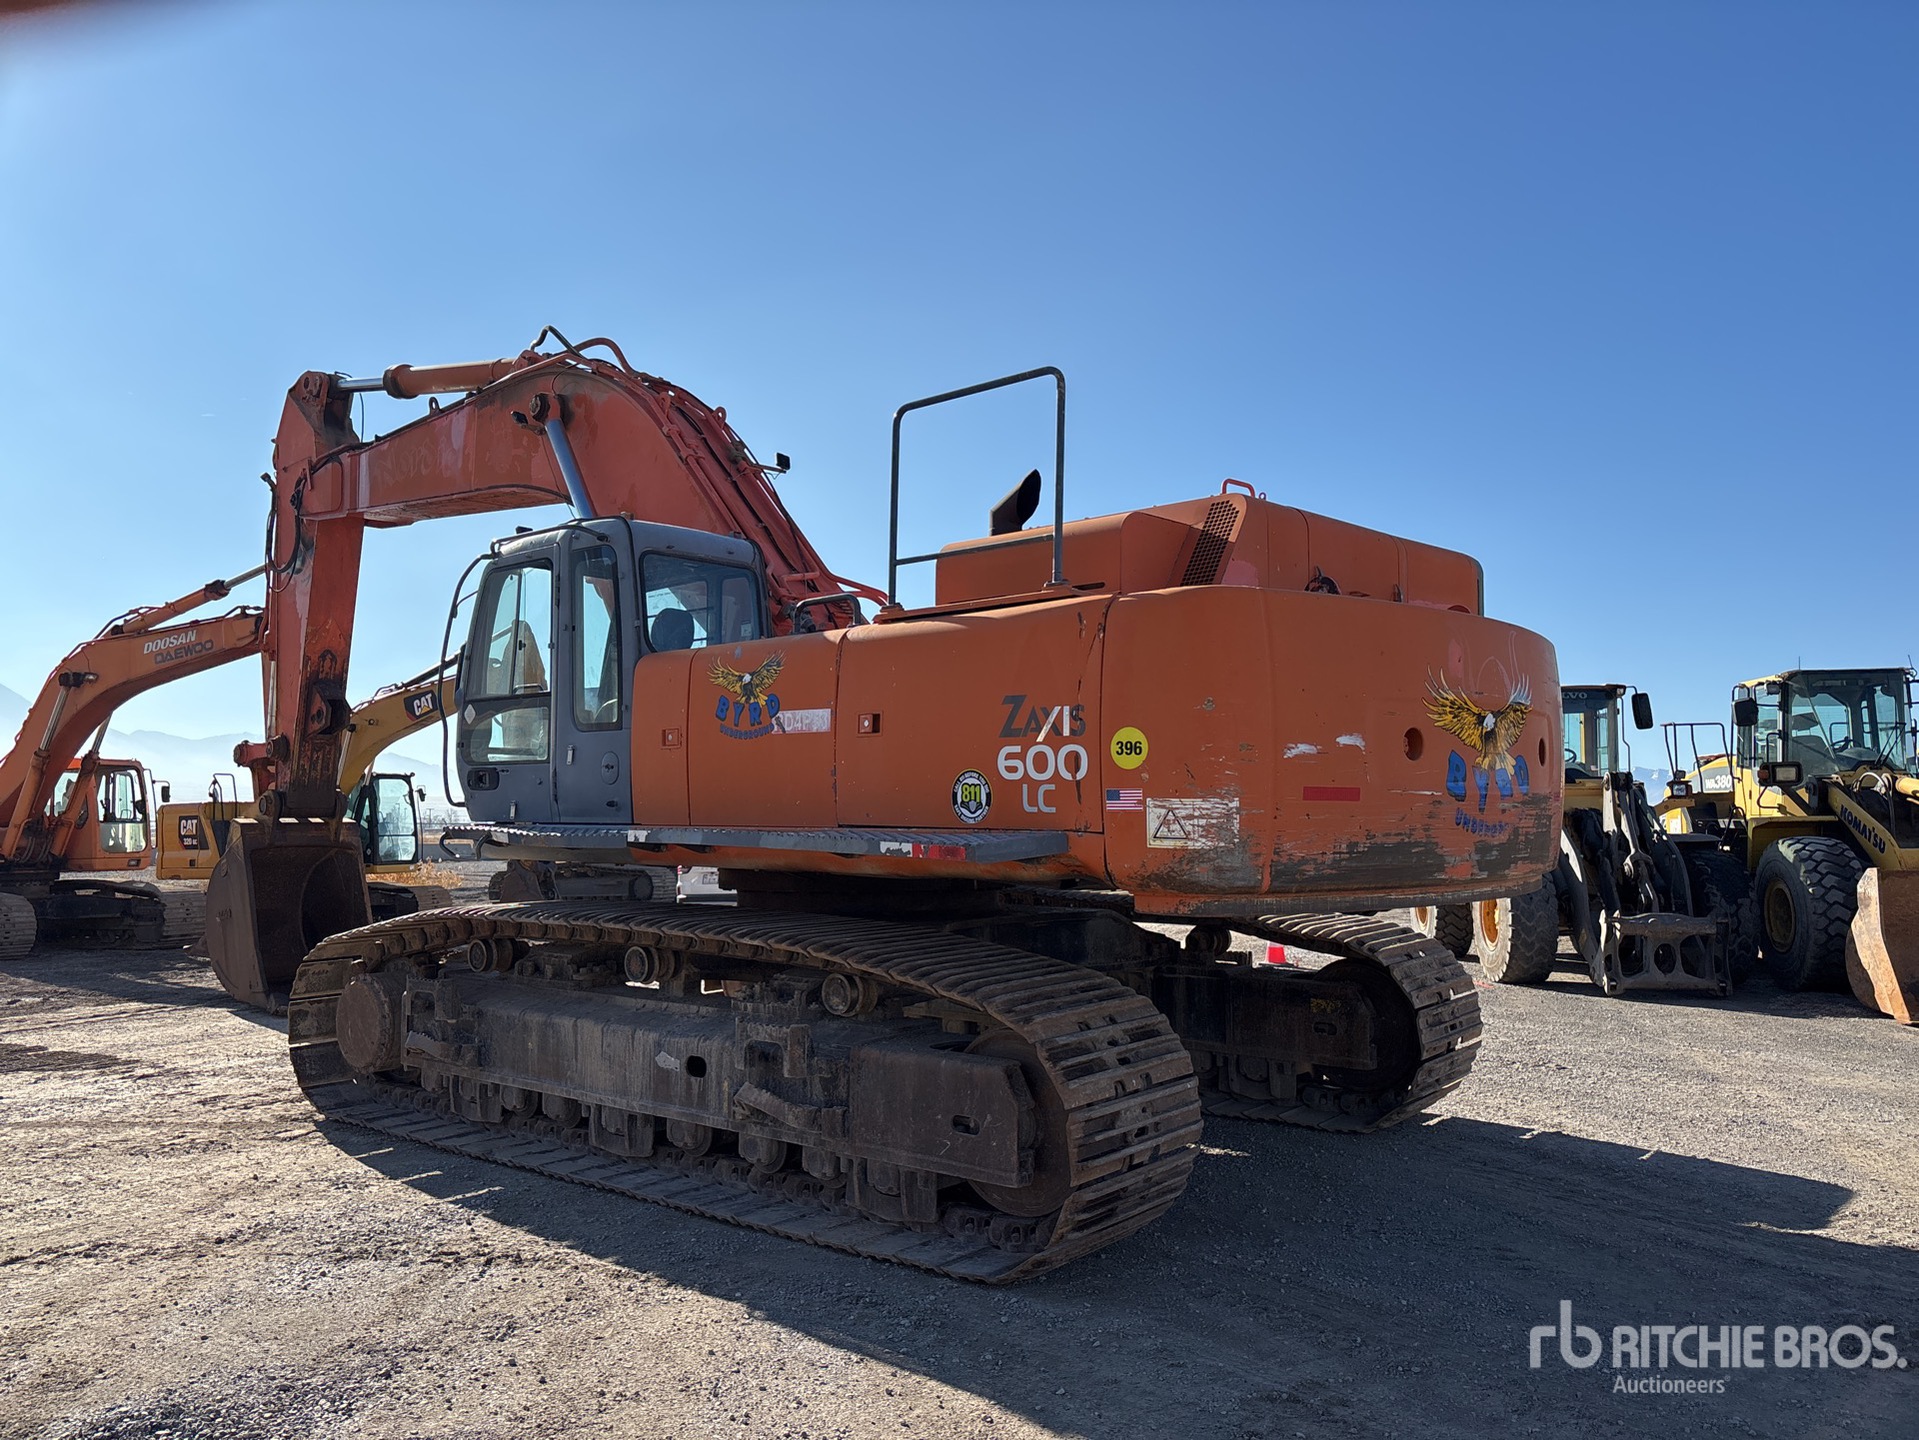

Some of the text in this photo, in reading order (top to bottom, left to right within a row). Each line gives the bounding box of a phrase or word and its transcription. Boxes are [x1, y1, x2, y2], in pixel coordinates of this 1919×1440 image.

[143, 630, 197, 655] DOOSAN
[154, 639, 214, 665] DAEWOO
[413, 692, 433, 716] CAT
[1562, 691, 1588, 699] LVO
[716, 694, 780, 727] BYRD
[999, 694, 1087, 742] ZAXIS
[720, 722, 775, 740] UNDERGROUND
[1115, 740, 1143, 756] 396
[997, 743, 1089, 781] 600
[962, 784, 980, 802] 811
[1705, 774, 1732, 789] WA380
[1022, 784, 1056, 813] LC
[180, 819, 198, 836] CAT
[1840, 804, 1886, 854] KOMATSU
